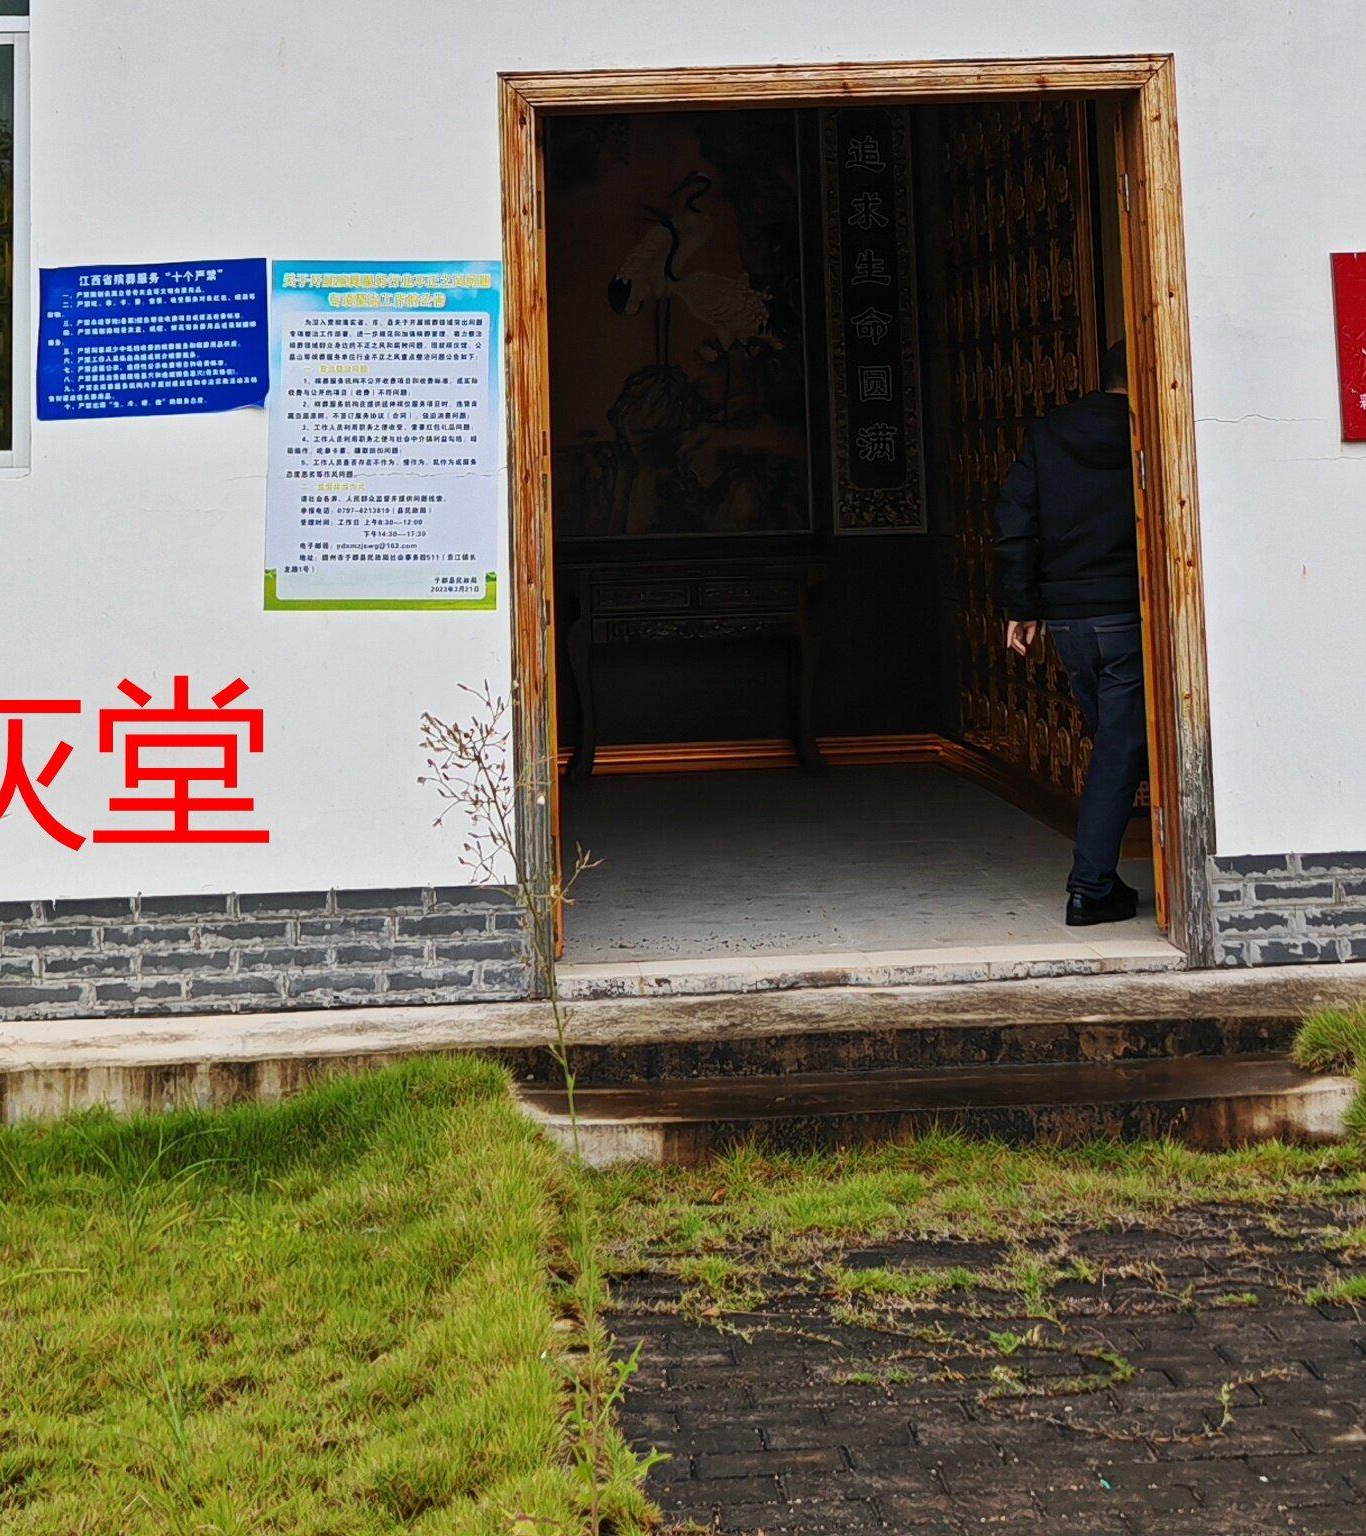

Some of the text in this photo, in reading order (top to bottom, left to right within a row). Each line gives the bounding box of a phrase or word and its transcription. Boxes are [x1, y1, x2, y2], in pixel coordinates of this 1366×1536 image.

[843, 134, 899, 465] 追求生命圆满
